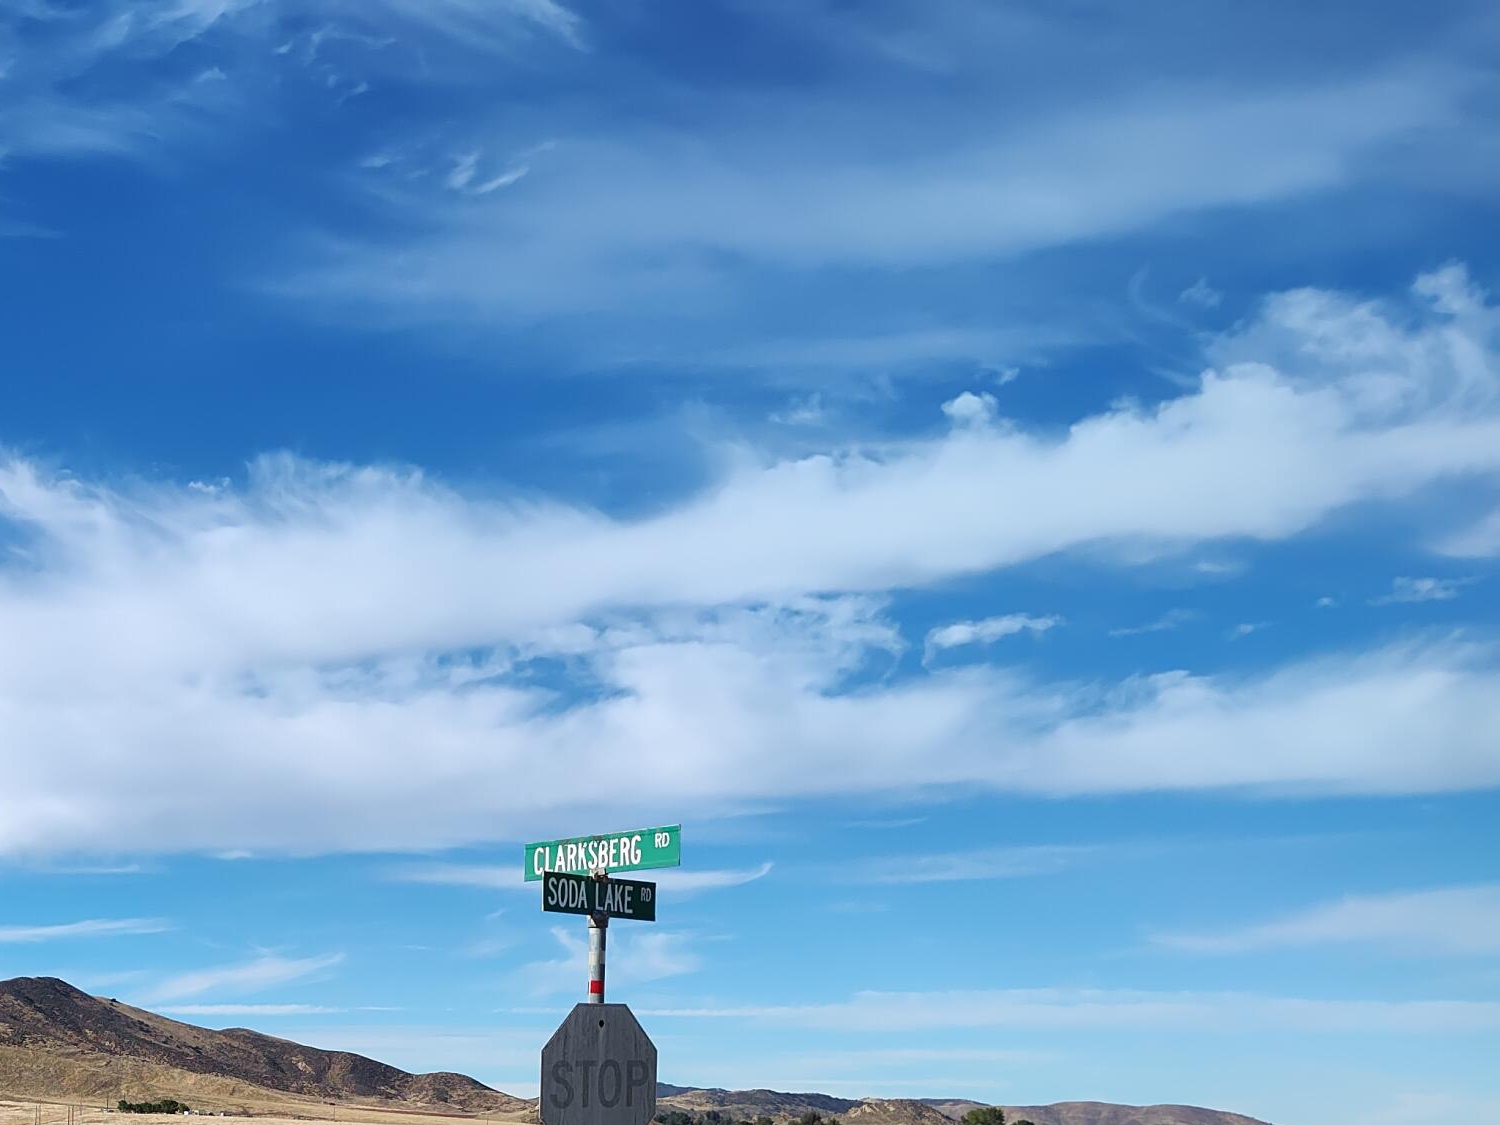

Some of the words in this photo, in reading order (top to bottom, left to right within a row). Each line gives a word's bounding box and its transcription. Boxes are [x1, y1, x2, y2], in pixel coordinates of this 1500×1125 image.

[533, 835, 642, 875] CLARKSBERG
[654, 832, 670, 848] RD
[548, 877, 588, 909] SODA
[595, 882, 634, 914] LAKE
[640, 887, 652, 902] RD
[550, 1059, 649, 1109] STOP
